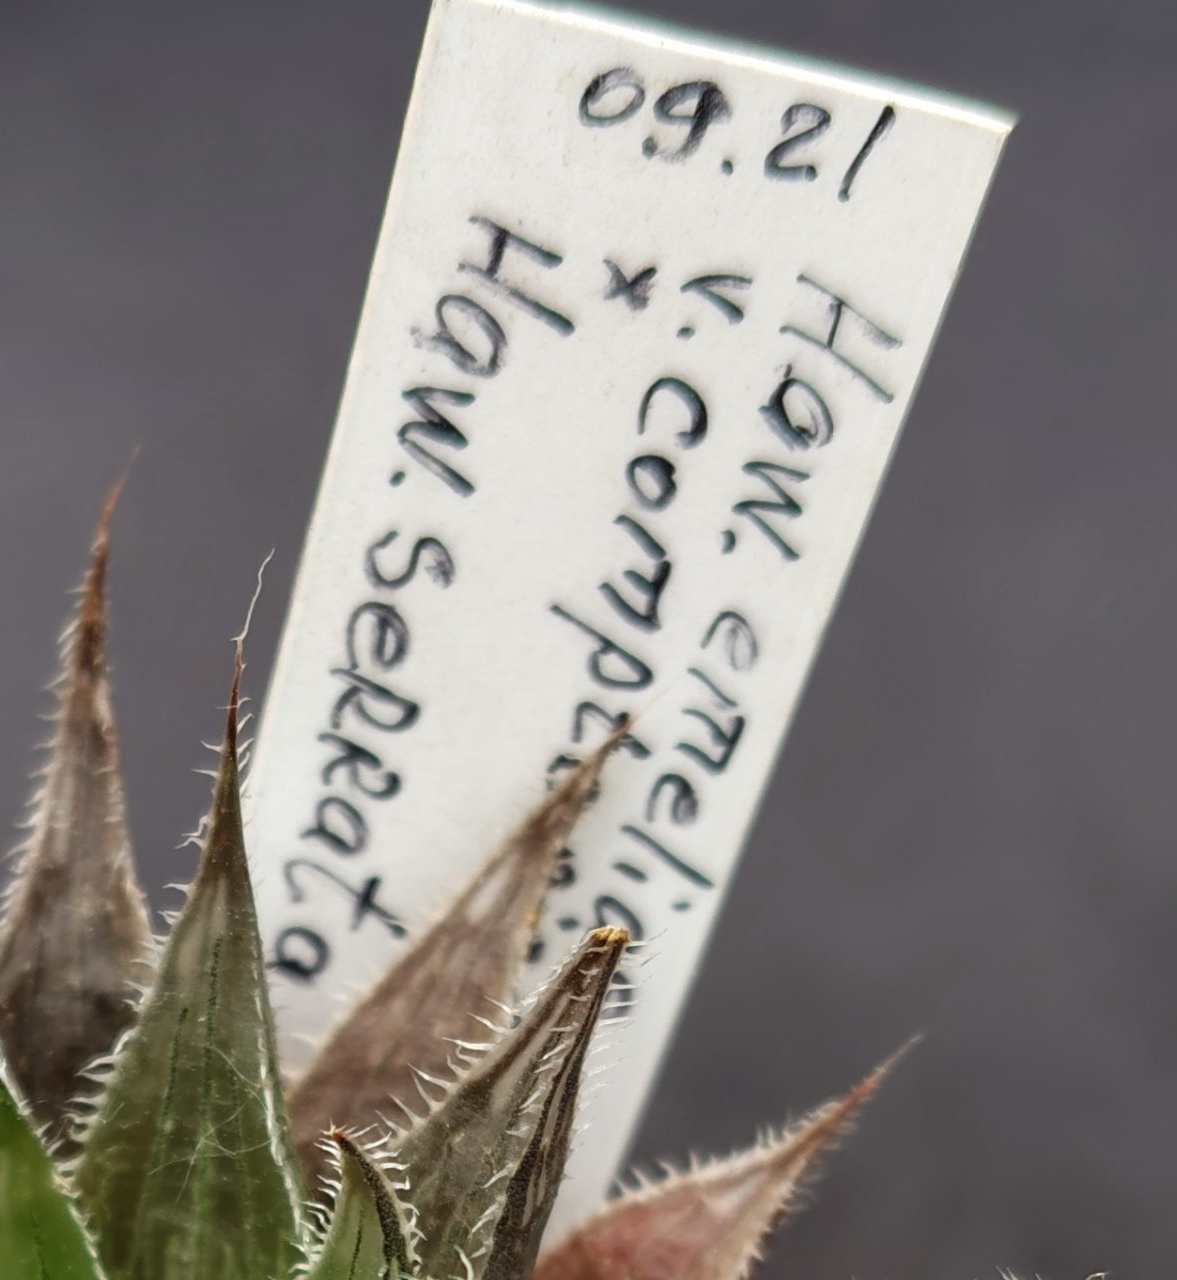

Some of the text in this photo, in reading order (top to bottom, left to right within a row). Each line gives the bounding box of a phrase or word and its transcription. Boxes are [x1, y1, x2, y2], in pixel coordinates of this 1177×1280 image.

[578, 66, 896, 203] 09.21
[388, 215, 576, 498] Haw.
[720, 272, 904, 562] Haw.
